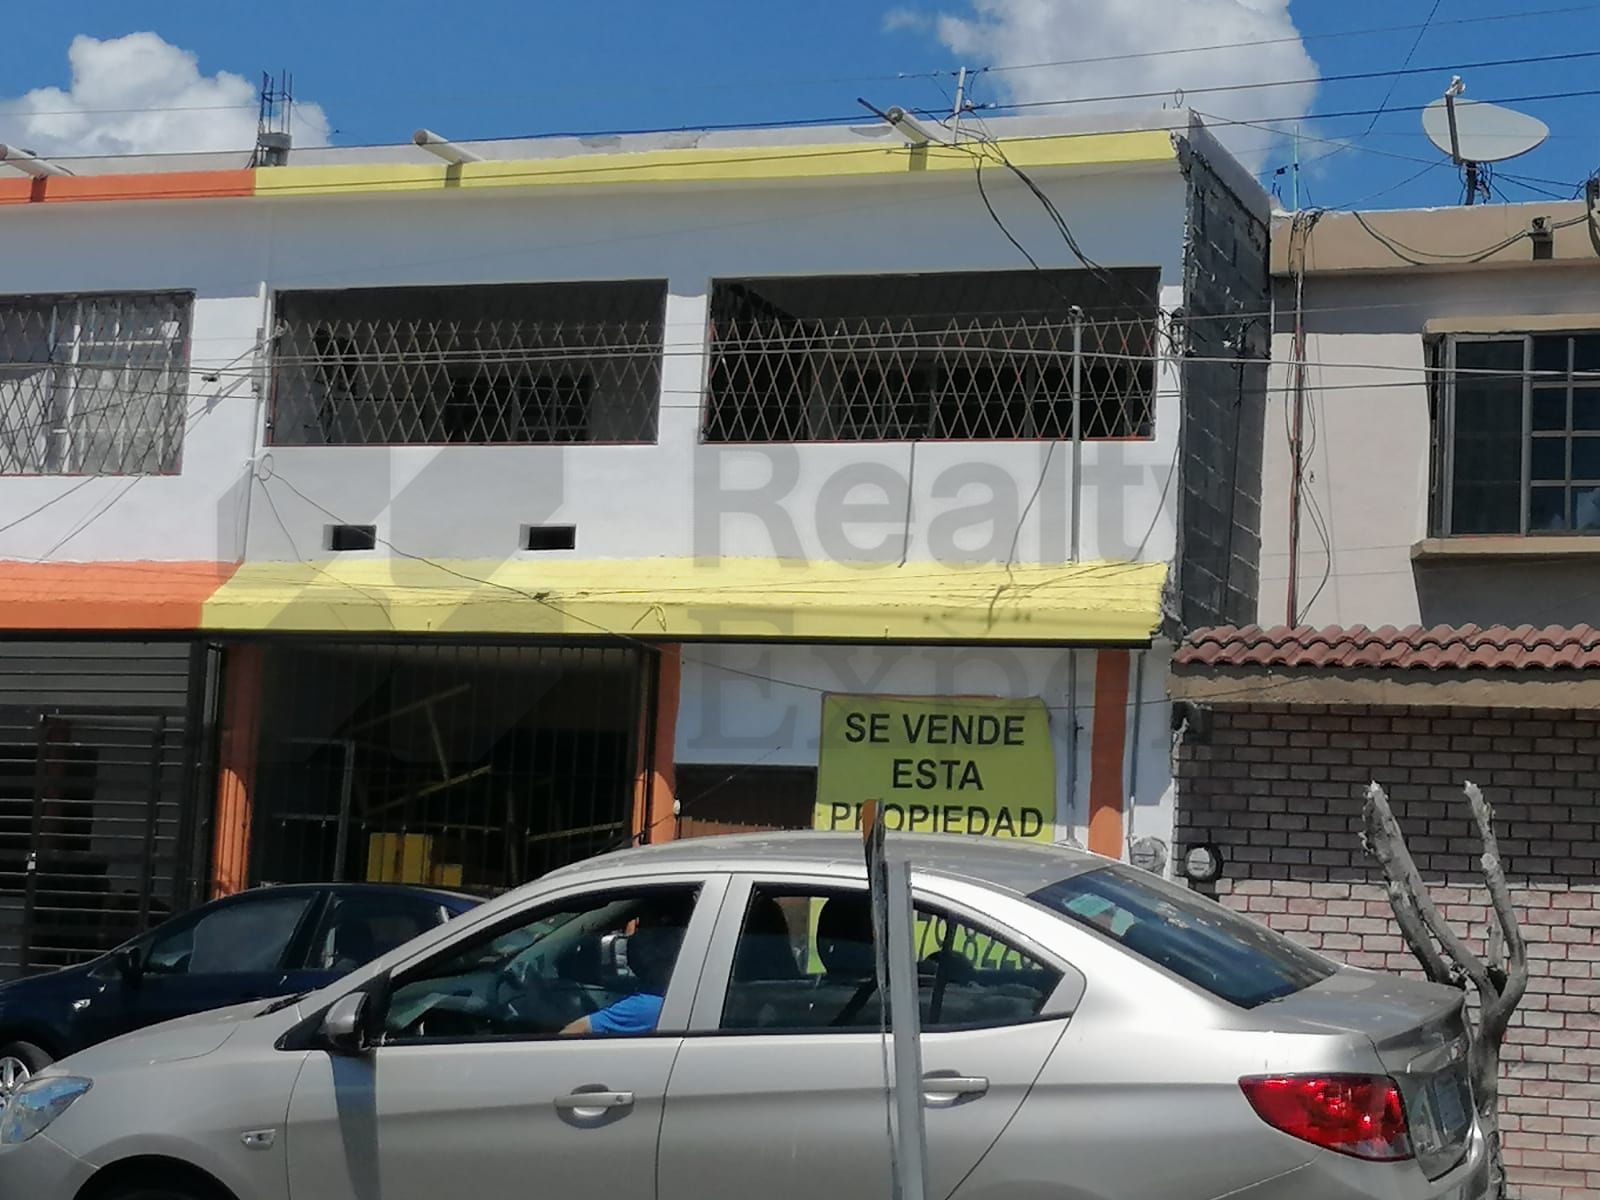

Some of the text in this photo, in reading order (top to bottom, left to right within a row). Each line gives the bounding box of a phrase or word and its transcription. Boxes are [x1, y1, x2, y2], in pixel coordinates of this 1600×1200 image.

[845, 712, 1025, 746] SE VENDE
[892, 758, 984, 791] ESTA
